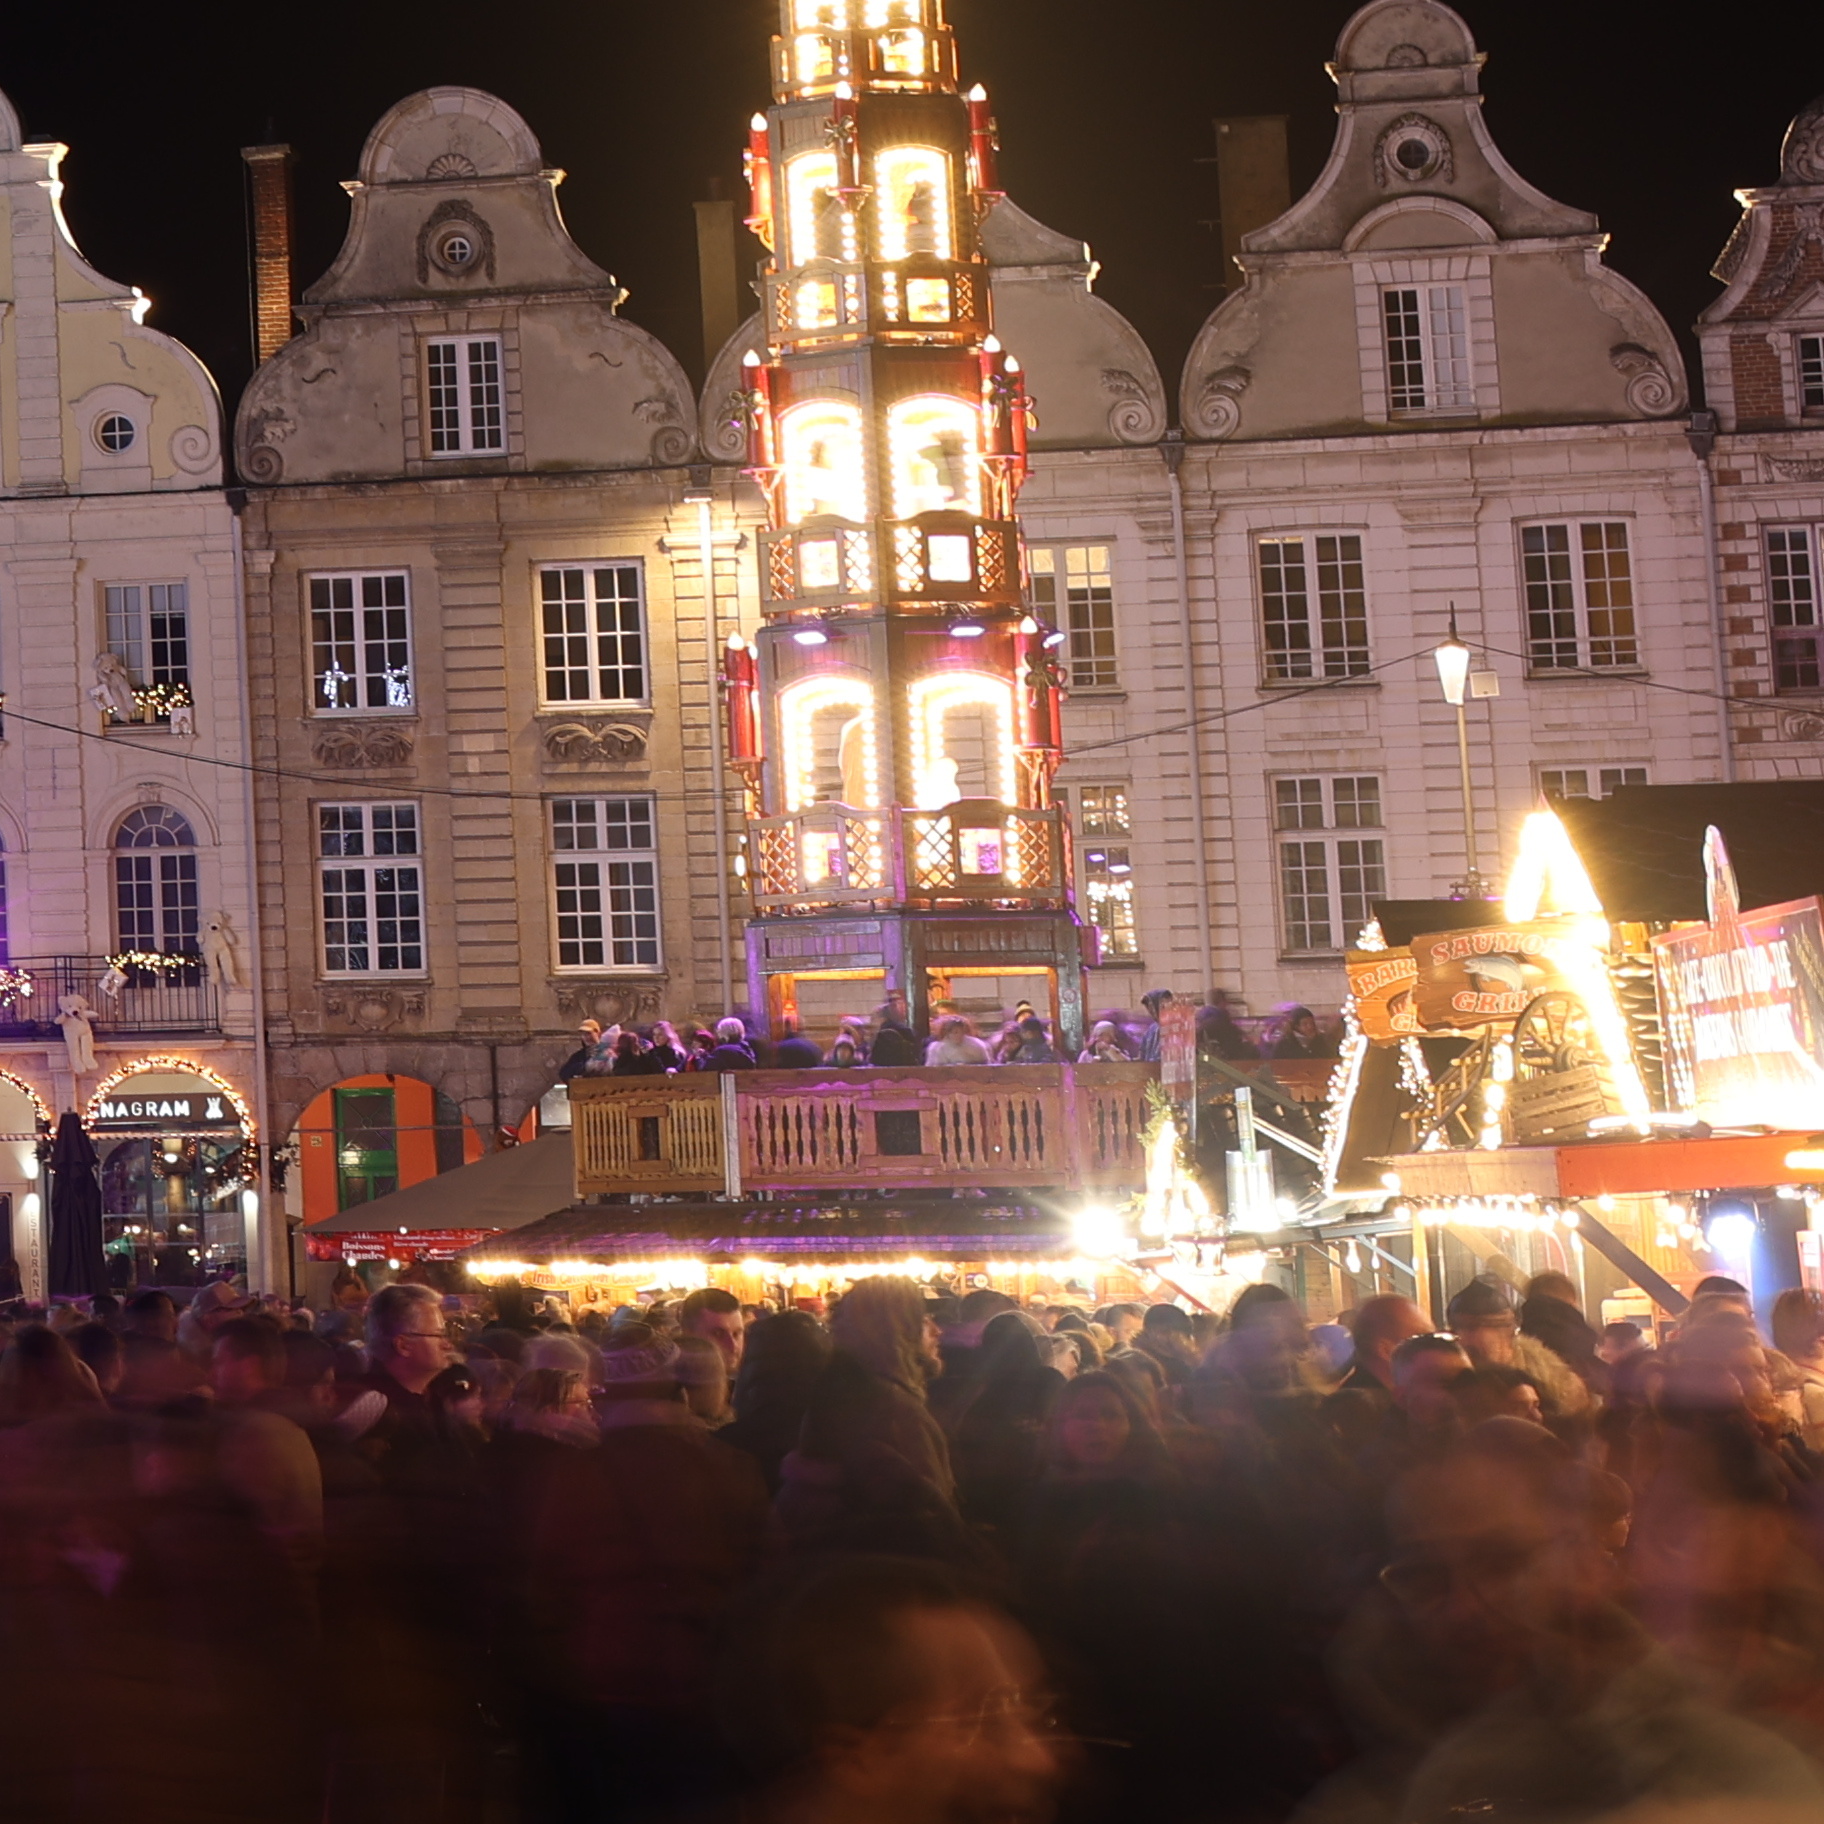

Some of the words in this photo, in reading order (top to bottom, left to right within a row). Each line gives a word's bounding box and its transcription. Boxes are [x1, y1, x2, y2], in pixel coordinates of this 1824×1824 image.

[1431, 932, 1550, 966] SAUMO
[31, 1211, 40, 1297] ESTAURANT
[342, 1241, 385, 1251] Boissons
